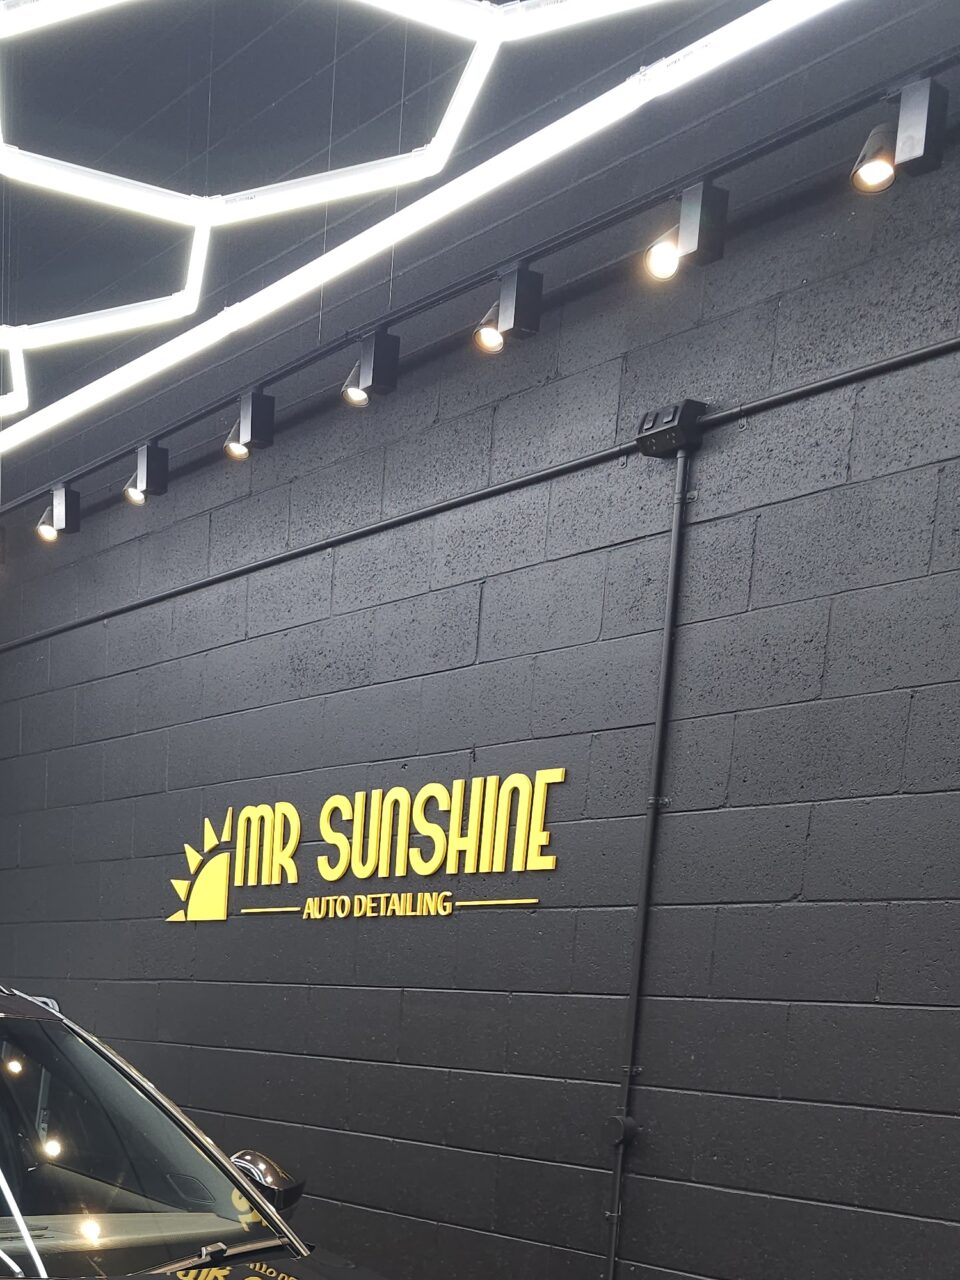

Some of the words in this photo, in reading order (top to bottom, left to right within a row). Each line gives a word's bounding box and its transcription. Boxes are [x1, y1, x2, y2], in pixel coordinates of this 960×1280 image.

[234, 802, 300, 886] MR
[317, 768, 566, 882] SUNSHINE
[303, 895, 351, 919] AUTO
[353, 891, 453, 917] DETAILING
